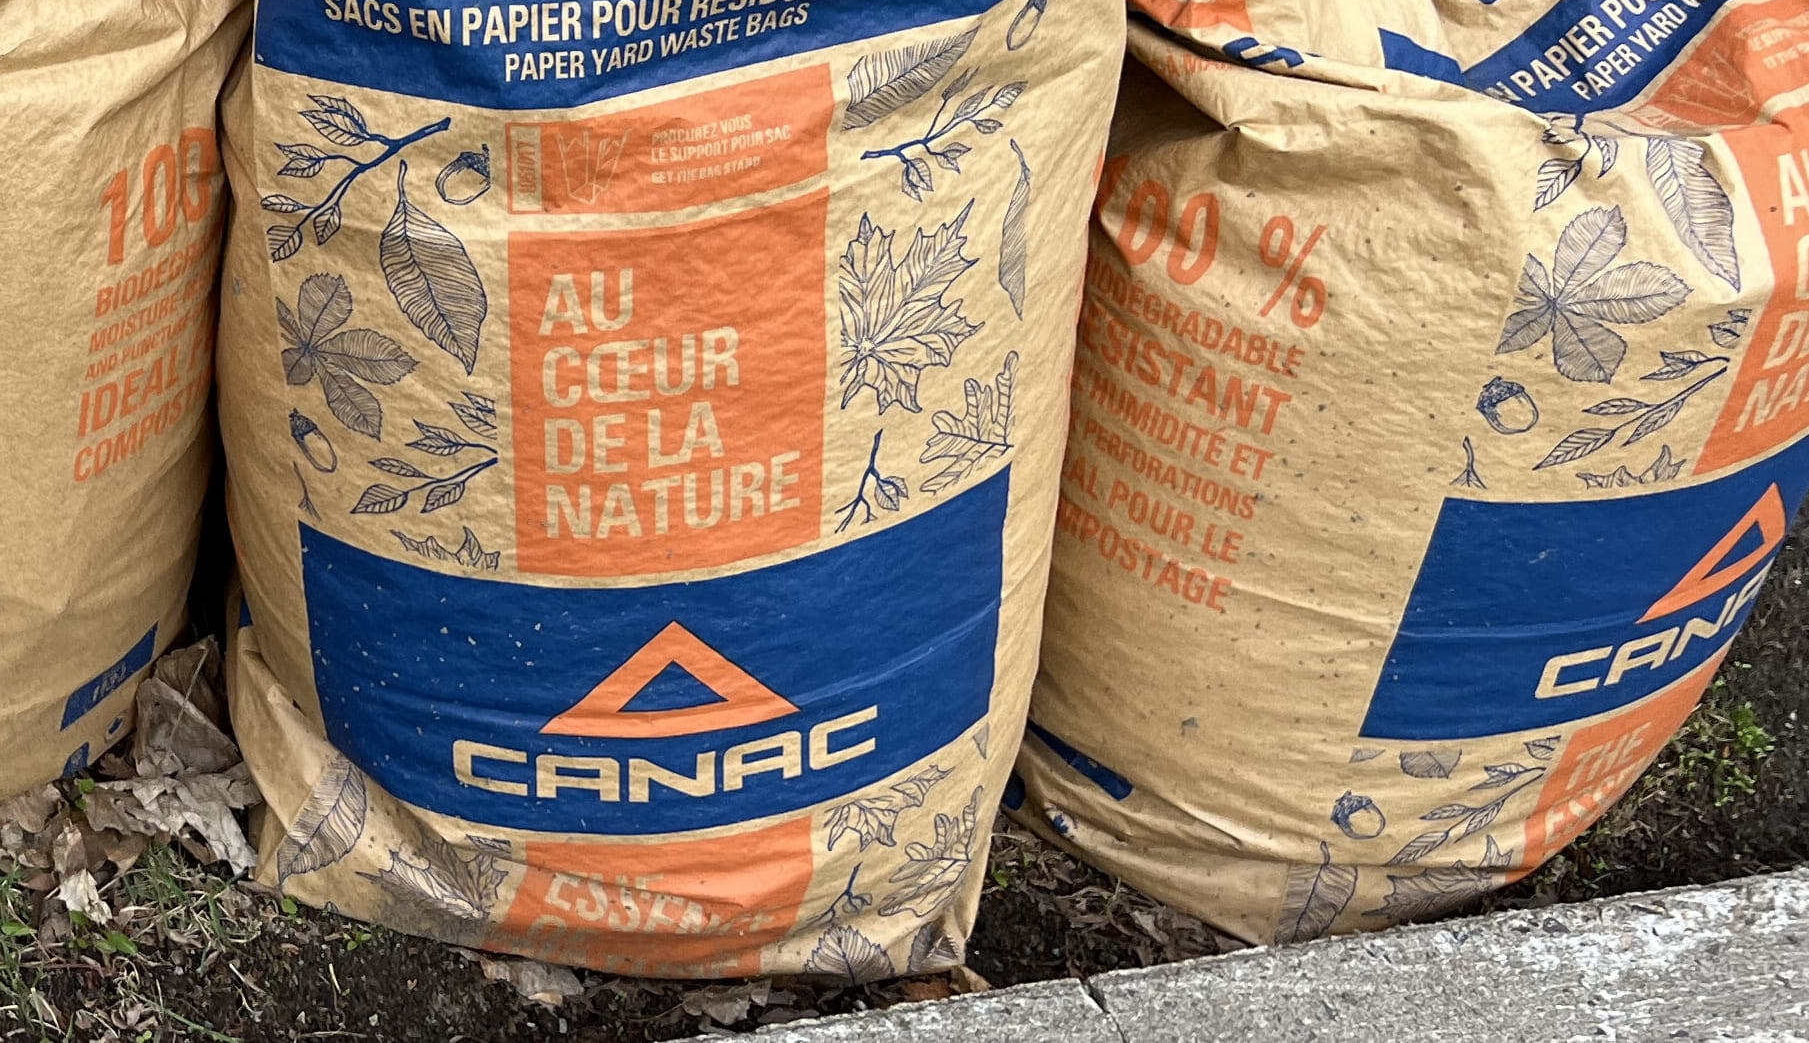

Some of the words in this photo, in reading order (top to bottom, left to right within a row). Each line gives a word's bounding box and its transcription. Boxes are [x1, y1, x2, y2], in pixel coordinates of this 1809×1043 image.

[408, 7, 453, 47] EN
[461, 0, 583, 47] PAPIER
[505, 49, 585, 83] PAPER
[591, 37, 654, 76] YARD
[659, 17, 742, 59] WASTE
[745, 2, 811, 38] BAGS
[1509, 14, 1616, 98] PAPIER
[1570, 43, 1643, 102] PAPER
[1628, 7, 1690, 54] YARD
[651, 146, 667, 164] LE
[669, 139, 729, 162] SUPPORT
[731, 130, 765, 152] POUR
[765, 124, 792, 145] SAC
[651, 170, 674, 184] GET
[100, 126, 219, 268] 100
[538, 267, 634, 337] AU
[1258, 213, 1328, 329] %
[77, 342, 180, 440] IDEAL
[542, 325, 741, 408] CŒUR
[1081, 305, 1294, 437] ESISTANT
[545, 412, 629, 475] DE
[646, 399, 726, 470] LA
[1083, 416, 1258, 522] PERFORATIONS
[1229, 443, 1275, 482] ET
[545, 449, 801, 540] NATURE
[1108, 477, 1196, 547] POUR
[1201, 523, 1245, 566] LE
[1058, 496, 1234, 612] MPOSTAGE
[451, 704, 879, 804] CANAC
[1565, 721, 1652, 791] THE
